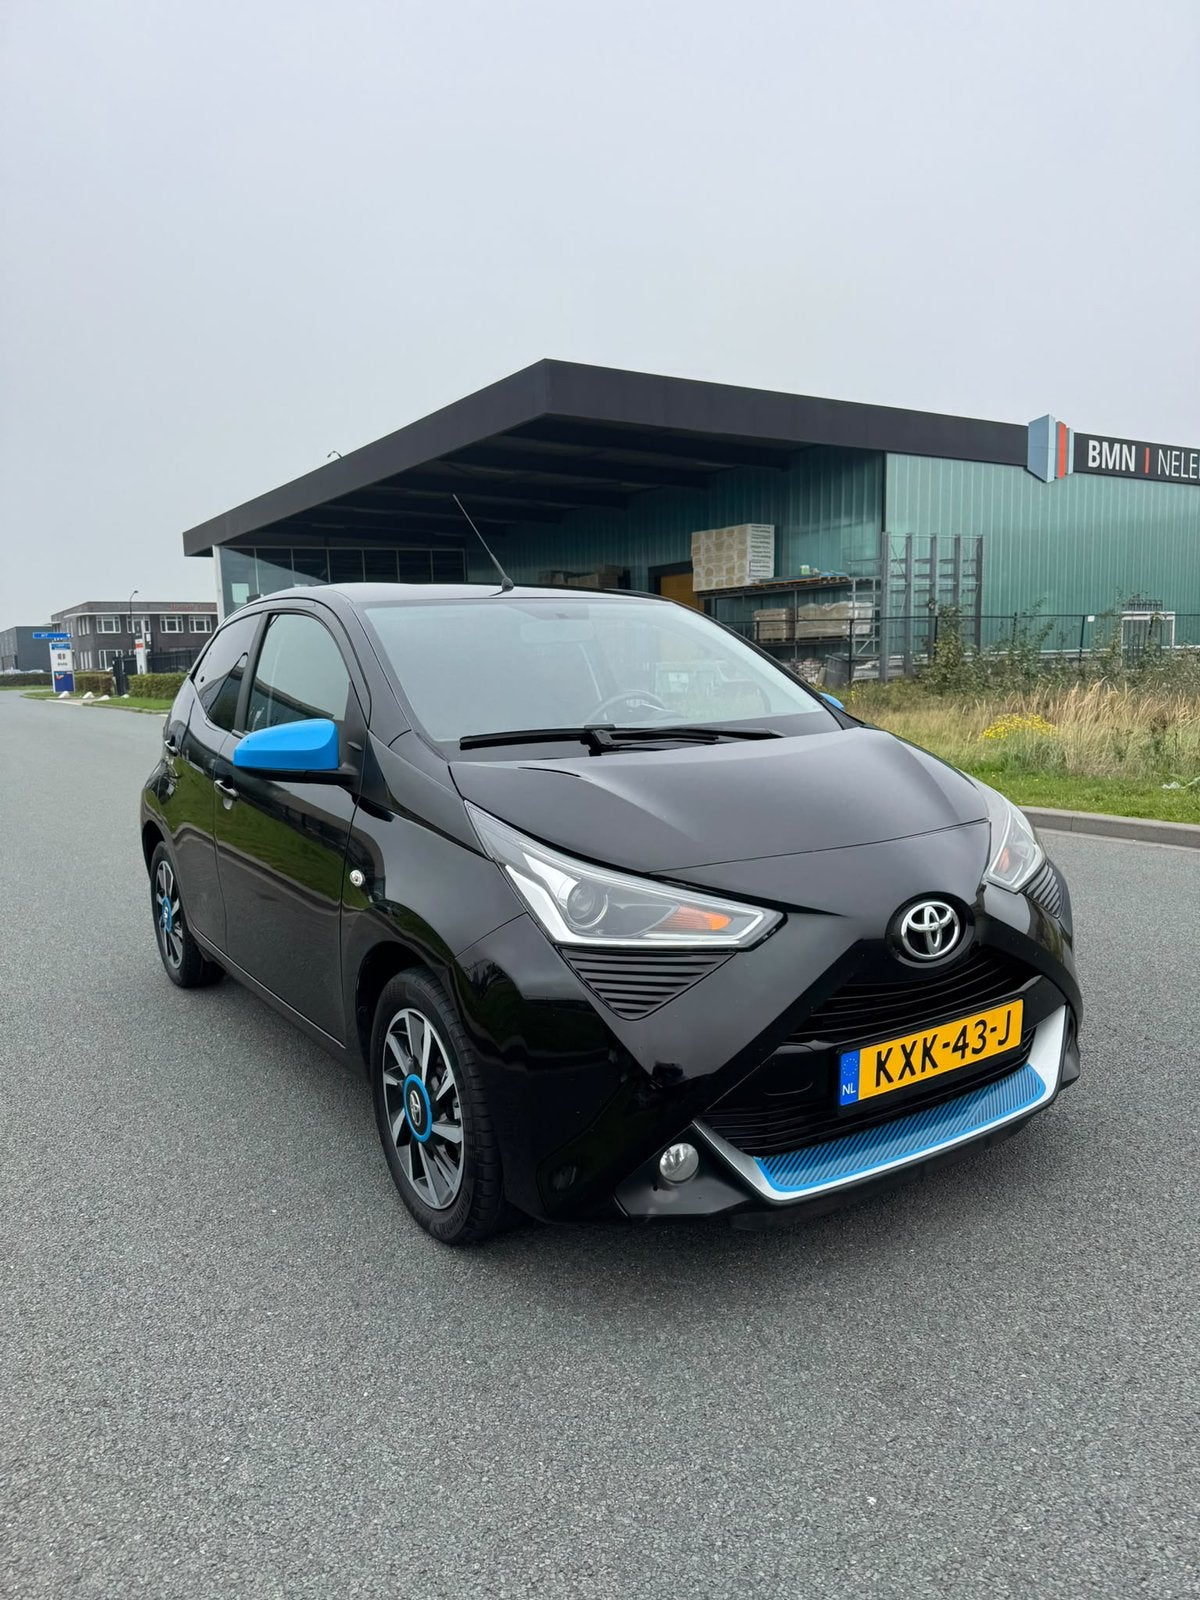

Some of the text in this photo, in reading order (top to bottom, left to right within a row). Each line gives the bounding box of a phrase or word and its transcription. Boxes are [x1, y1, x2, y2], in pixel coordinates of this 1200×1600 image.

[1088, 439, 1200, 479] BMN NELE
[875, 1010, 1012, 1088] KXK-43-J
[842, 1082, 857, 1096] NL
